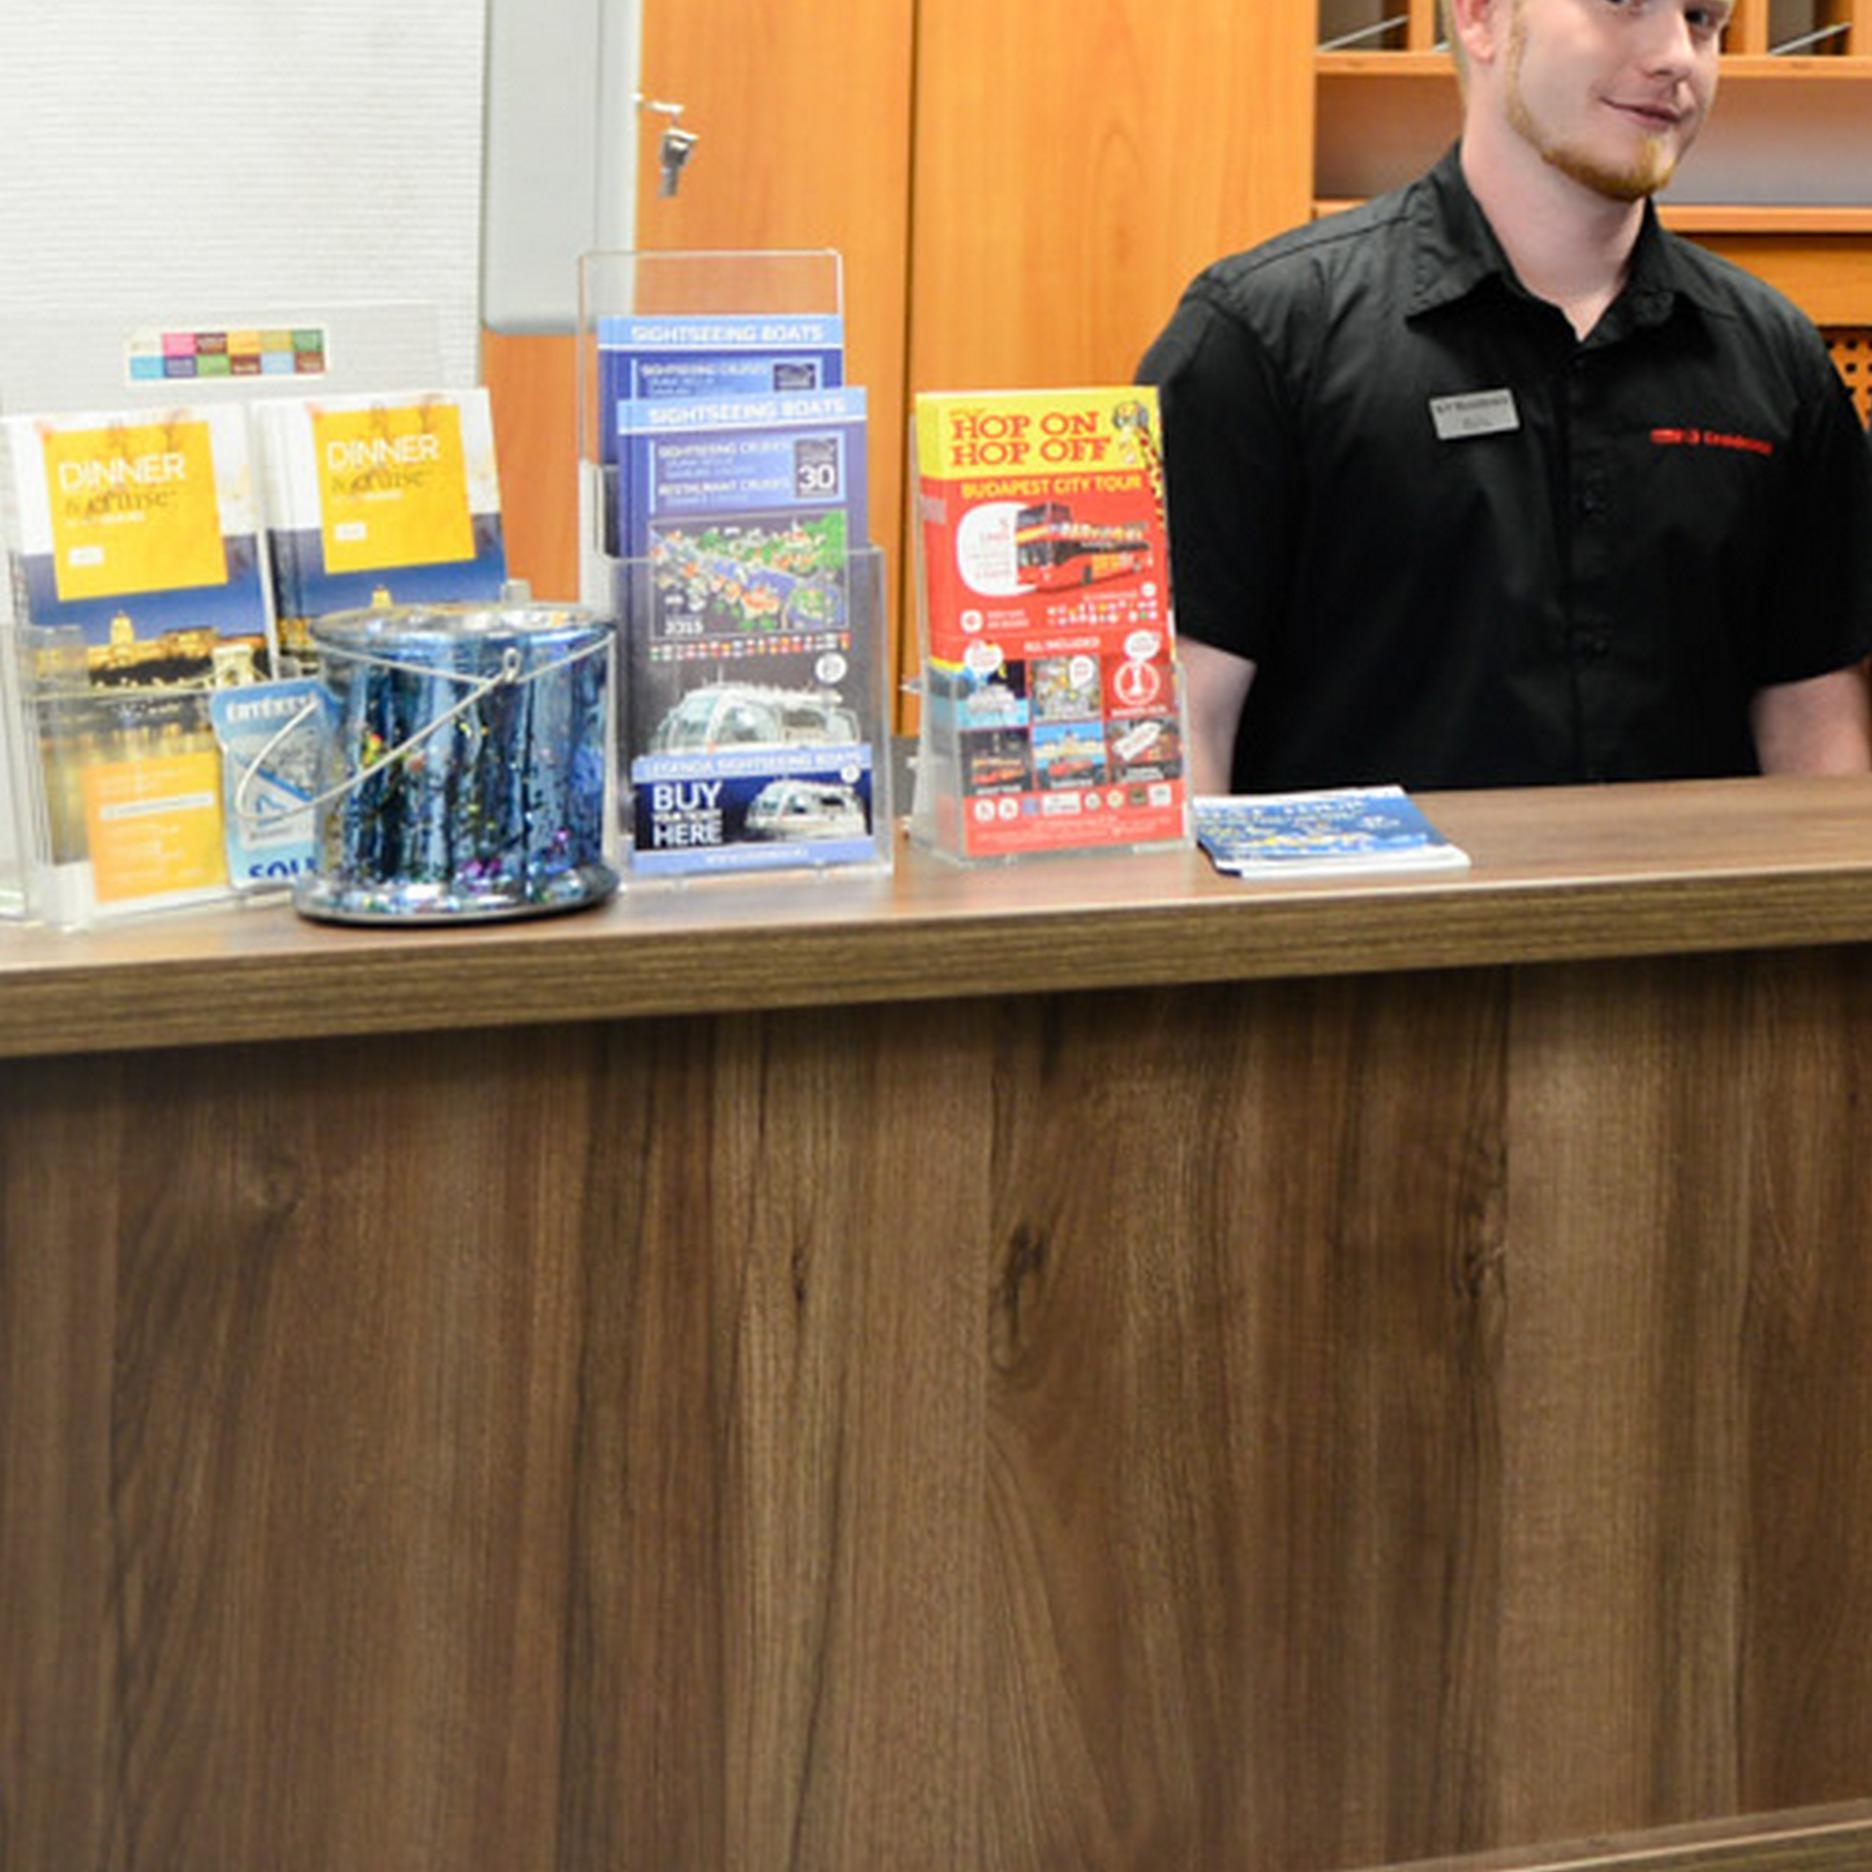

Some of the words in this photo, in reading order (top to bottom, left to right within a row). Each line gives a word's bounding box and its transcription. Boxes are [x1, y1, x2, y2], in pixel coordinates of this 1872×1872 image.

[631, 324, 757, 343] SIGHTSEEING
[761, 323, 825, 343] BOATS
[648, 400, 777, 424] SIGHTSEEING
[781, 396, 846, 418] BOATS
[950, 414, 1031, 441] HOP
[1039, 410, 1099, 436] ON
[325, 433, 439, 473] DINNER
[950, 440, 1031, 467] HOP
[1039, 436, 1112, 463] OFF
[58, 451, 187, 494] DINNER
[798, 463, 836, 490] 30
[961, 478, 1050, 501] BUDAPEST
[1053, 476, 1093, 496] CITY
[1096, 473, 1142, 492] TOUR
[653, 782, 723, 811] BUY
[653, 819, 723, 848] HERE
